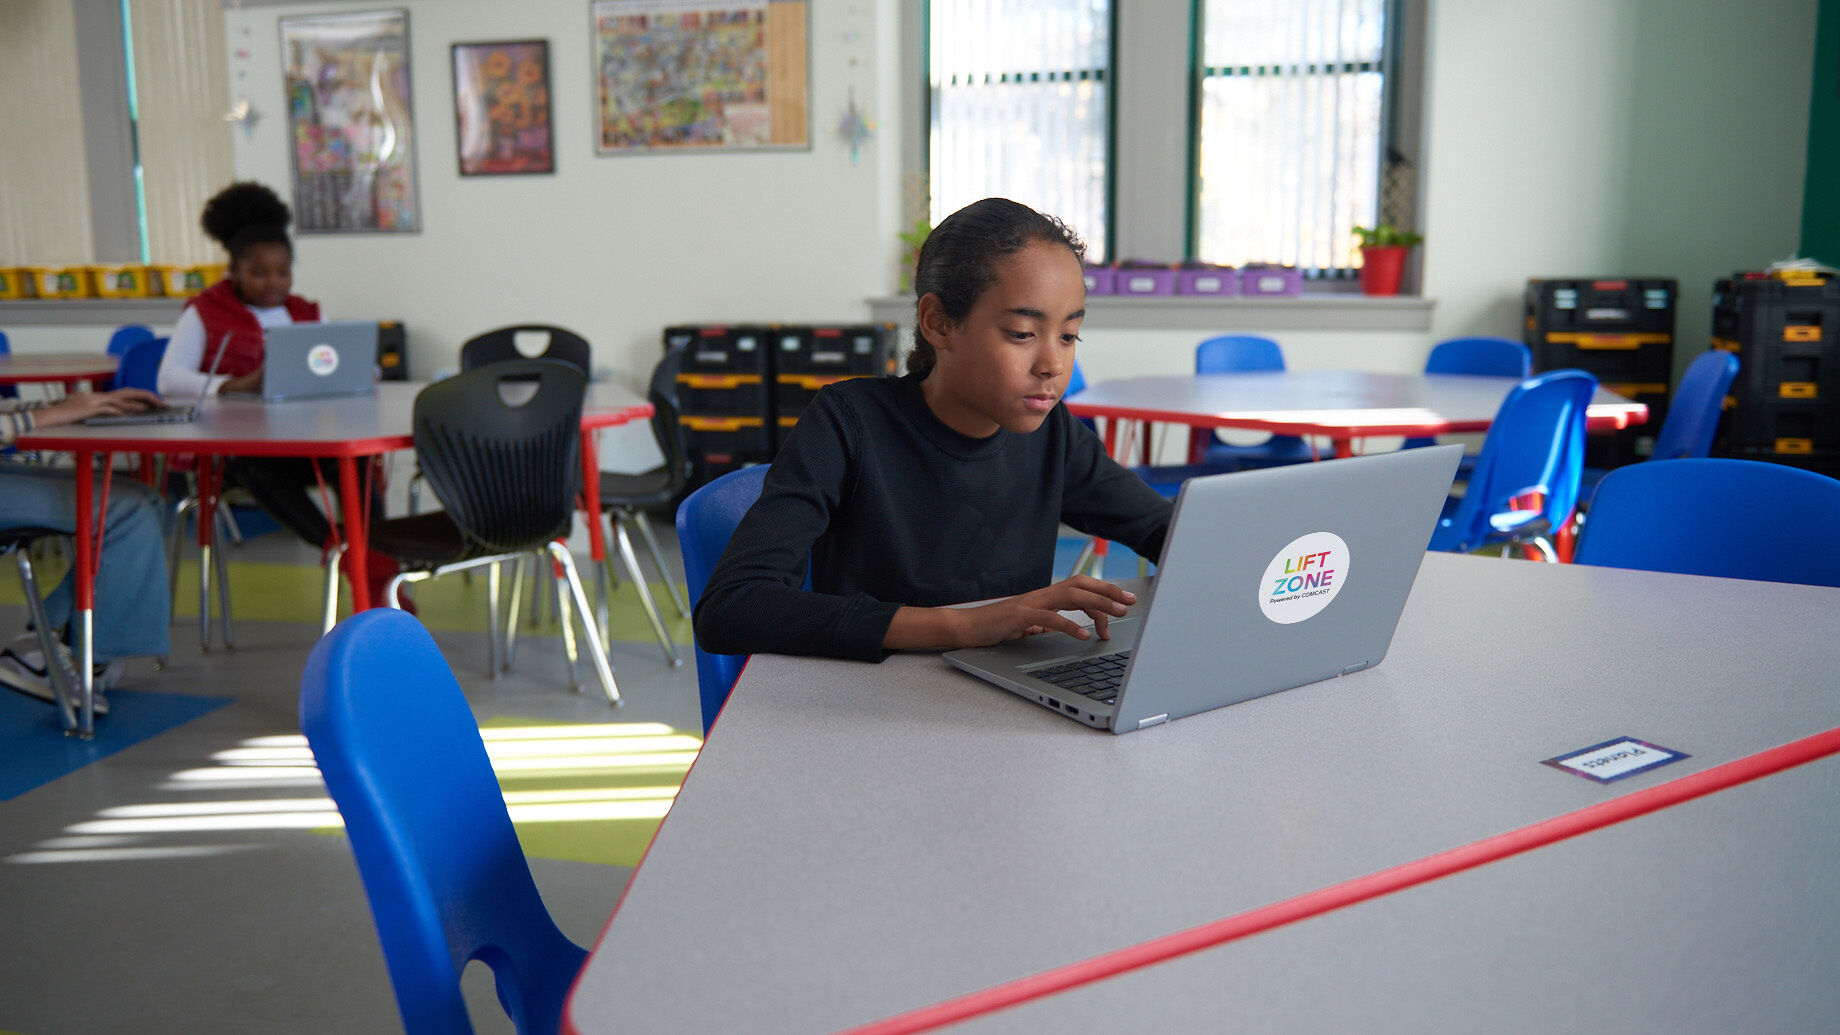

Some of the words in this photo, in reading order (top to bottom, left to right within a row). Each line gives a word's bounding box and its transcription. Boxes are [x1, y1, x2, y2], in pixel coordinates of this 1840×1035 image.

[1285, 551, 1331, 574] LIFT
[1272, 569, 1334, 595] ZONE
[1269, 595, 1293, 604] Powered
[1301, 588, 1330, 598] COMCAST
[1582, 747, 1647, 768] Planets
